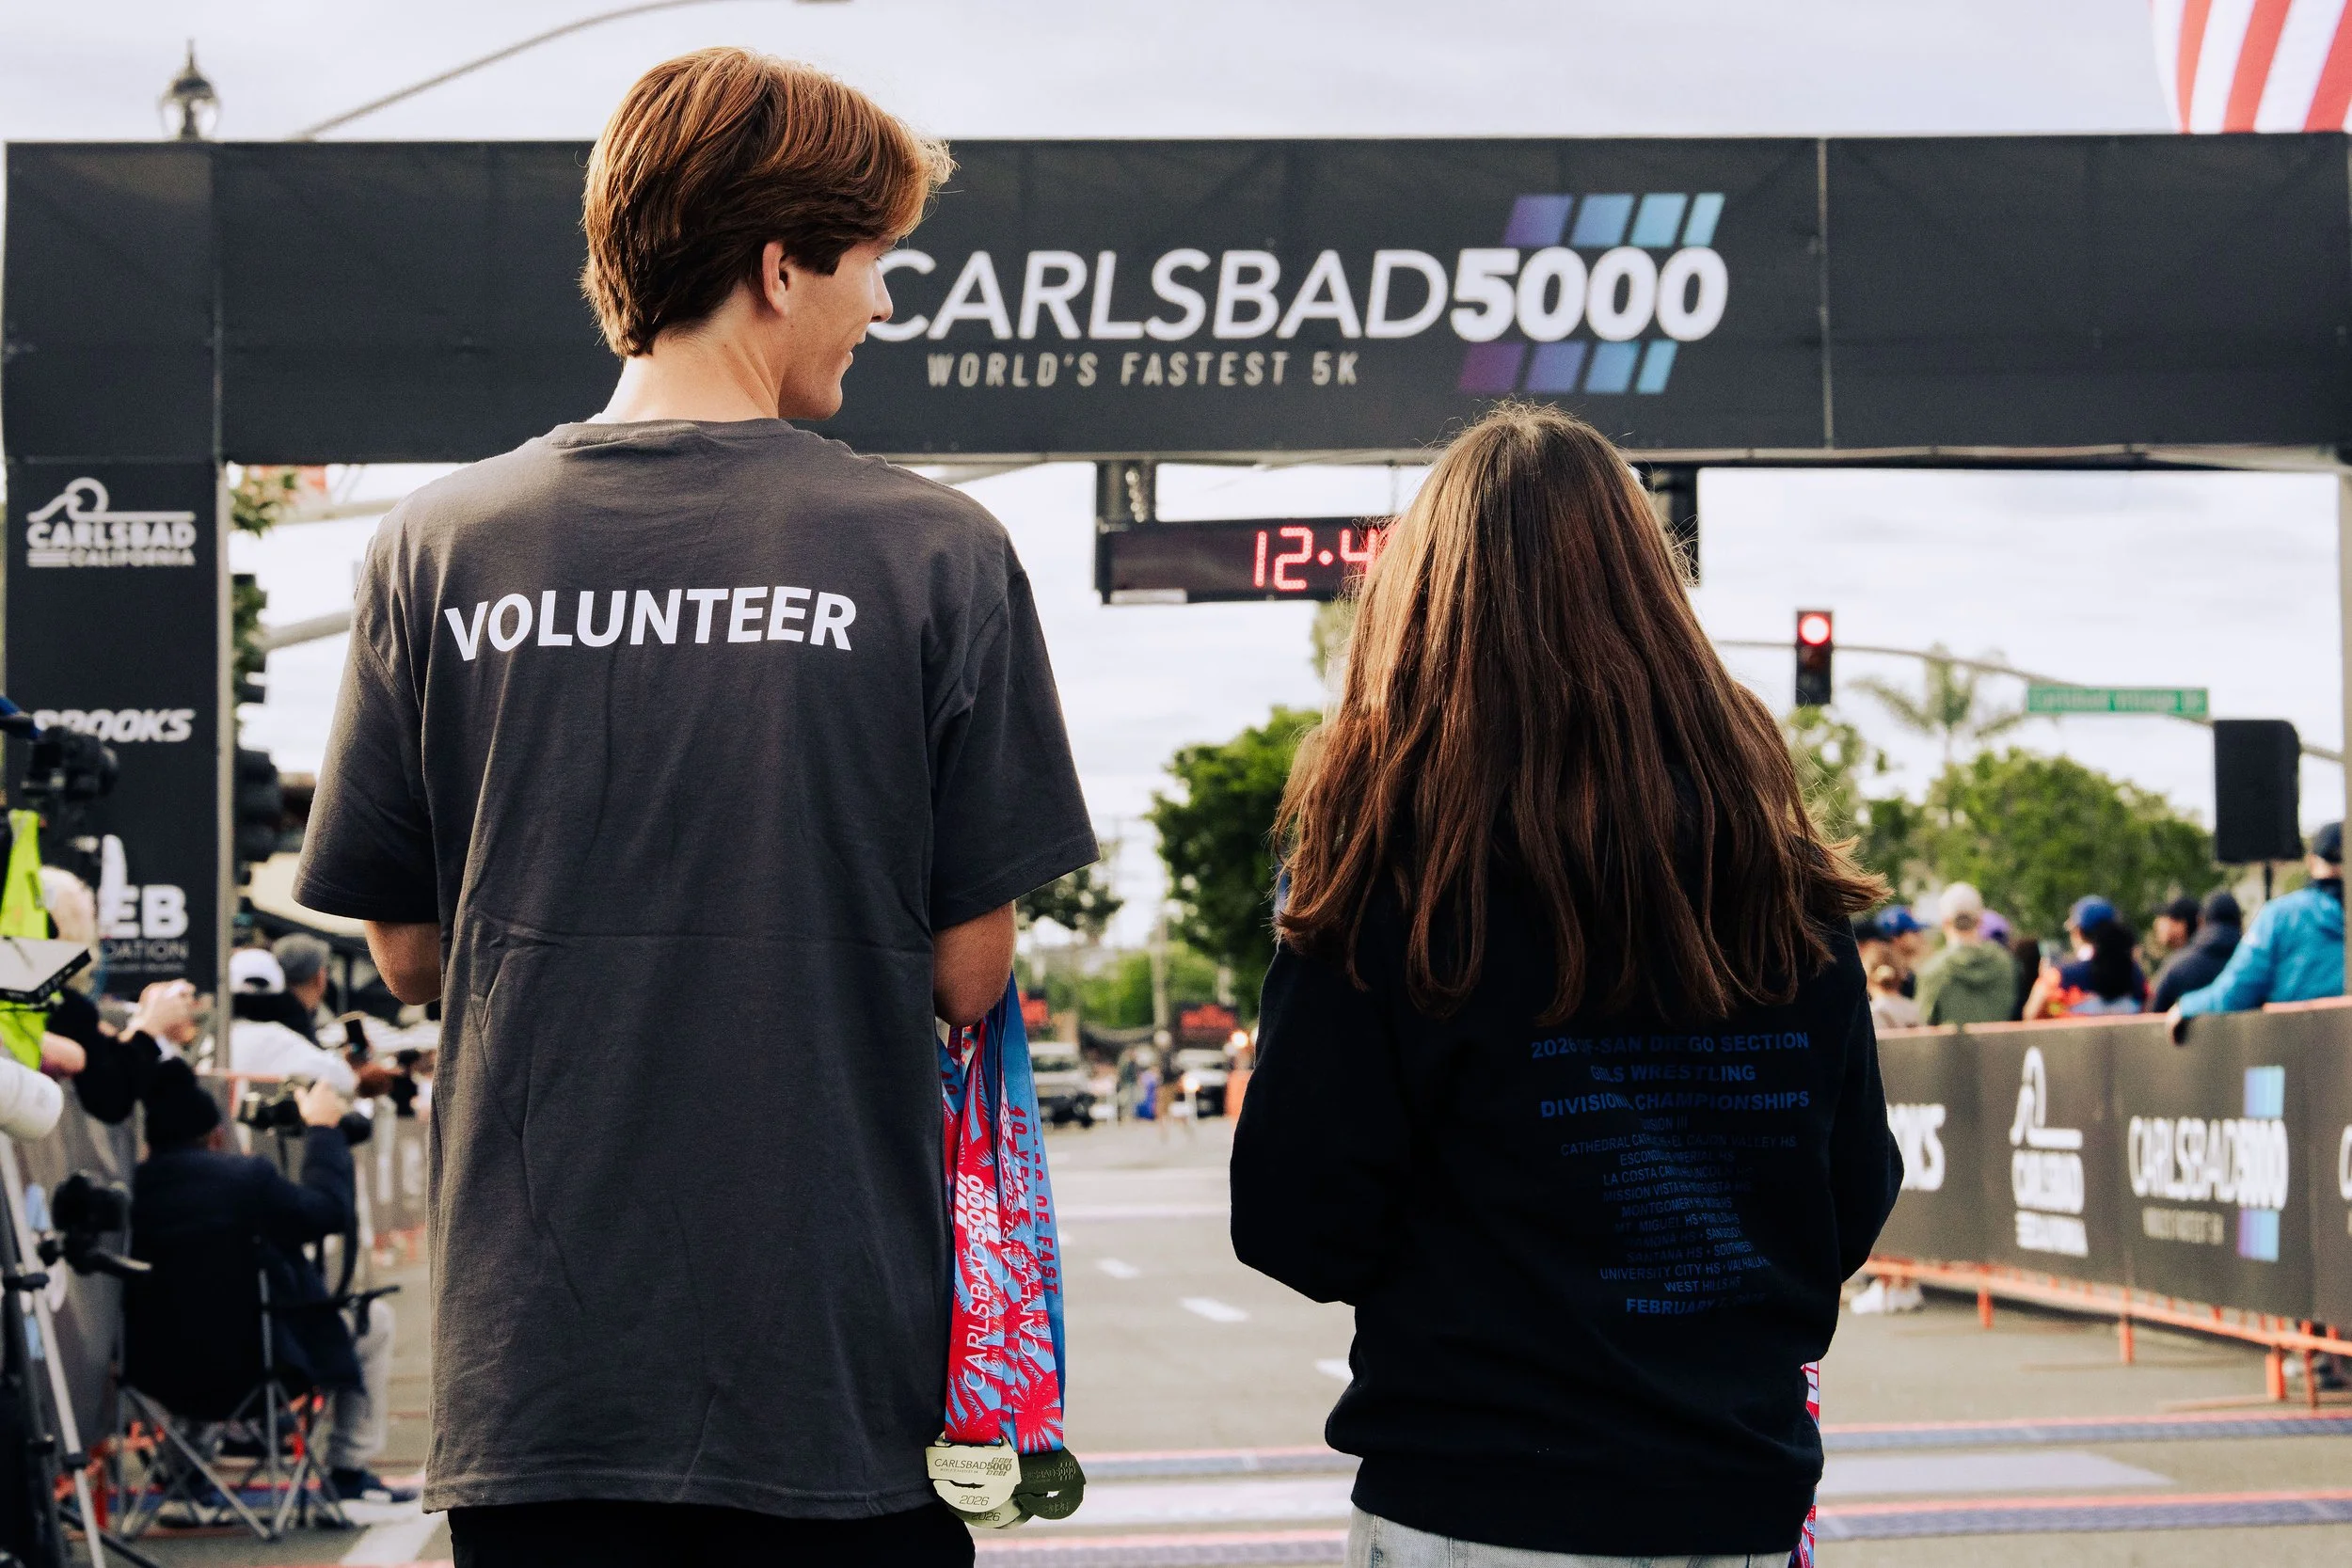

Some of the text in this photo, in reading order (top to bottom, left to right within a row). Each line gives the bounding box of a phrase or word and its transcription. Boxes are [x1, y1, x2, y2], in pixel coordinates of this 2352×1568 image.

[928, 352, 1359, 388] WORLD'S FASTEST 5K
[26, 522, 197, 548] CARLSBAD
[443, 586, 857, 661] VOLUNTEER
[1721, 1032, 1809, 1053] SECTION
[1630, 1064, 1756, 1082] WRESTLING
[1635, 1090, 1810, 1113] CHAMPIONSHIPS
[1561, 1136, 1630, 1156] CATHEDRAL
[1603, 1173, 1619, 1186] LA
[1621, 1168, 1658, 1184] COSTA
[1603, 1186, 1651, 1202] MISSION
[1684, 1213, 1699, 1227] HS
[1037, 1235, 1057, 1295] FAST
[1600, 1265, 1671, 1280] UNIVERSITY
[1674, 1263, 1702, 1277] CITY
[1706, 1261, 1721, 1275] HS
[963, 1174, 991, 1392] CARLSBAD5000
[1664, 1280, 1700, 1292] WEST
[1626, 1297, 1715, 1316] FEBRUARY
[934, 1458, 1012, 1472] CARLSBAD5000
[960, 1495, 989, 1506] 2026
